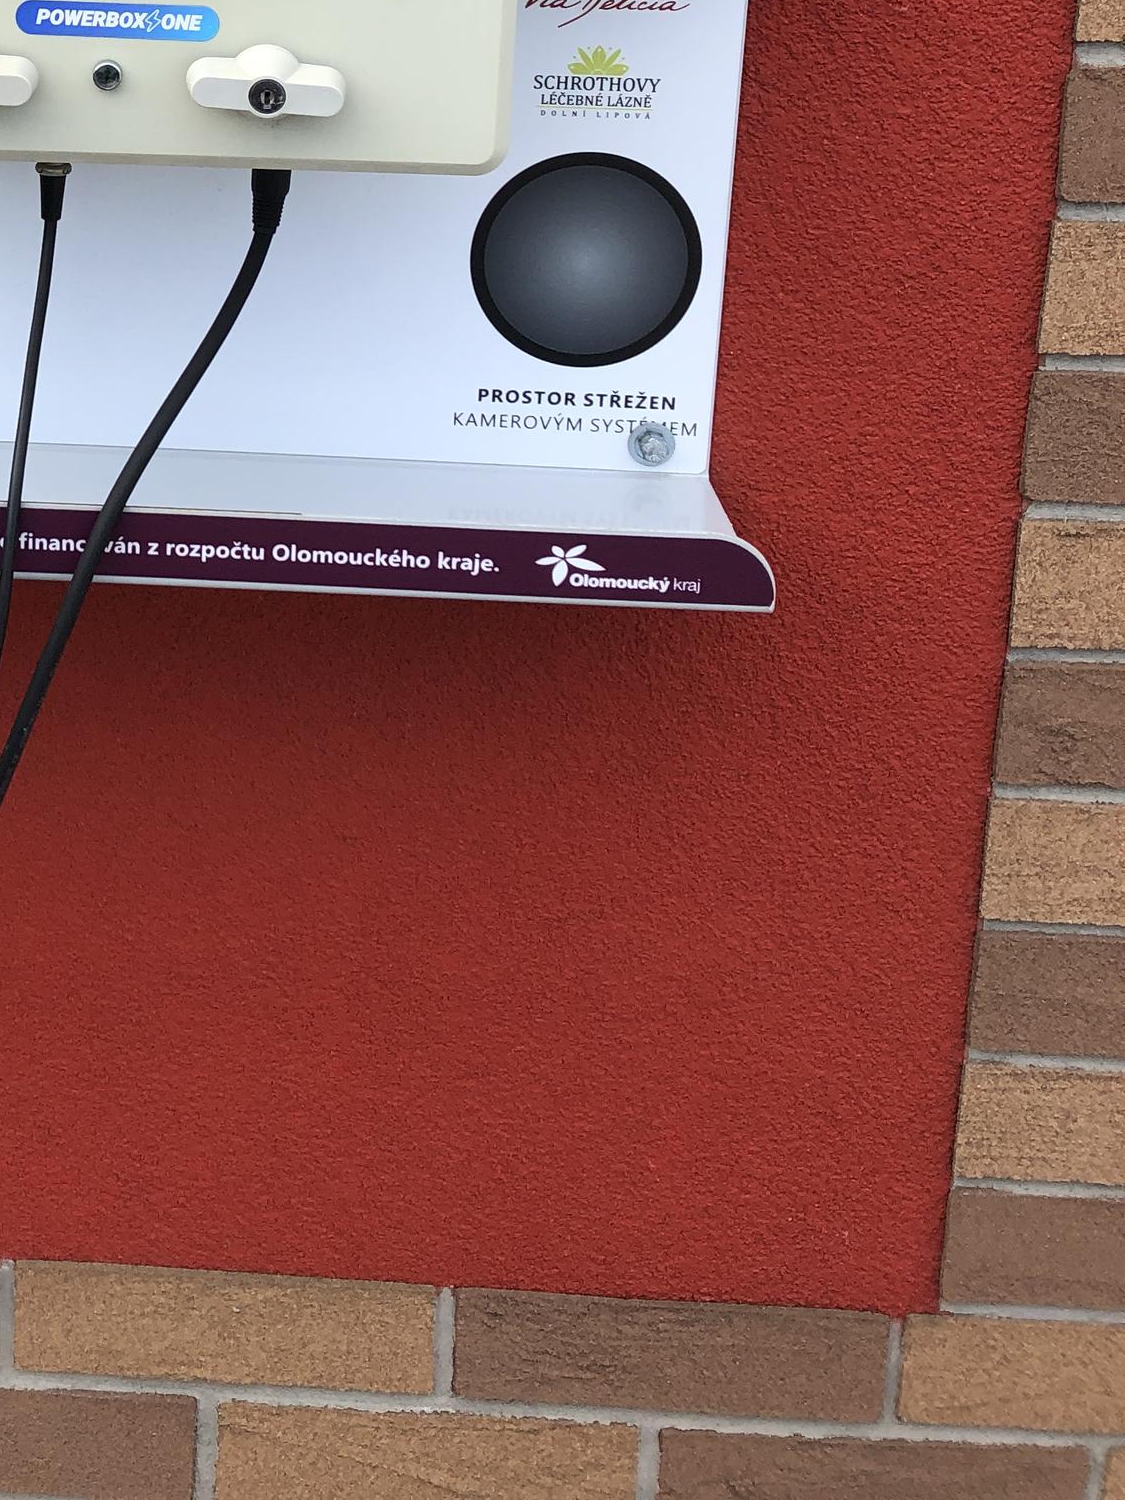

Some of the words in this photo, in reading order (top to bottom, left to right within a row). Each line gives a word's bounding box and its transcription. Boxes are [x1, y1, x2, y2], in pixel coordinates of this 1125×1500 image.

[533, 75, 661, 93] SCHROTHOVY
[541, 92, 603, 106] LÉČEBNÉ
[607, 94, 652, 108] LÁZNĚ
[597, 111, 651, 120] LIPOVÁ
[478, 388, 576, 407] PROSTOR
[583, 390, 675, 410] STŘEŽEN
[453, 412, 582, 432] KAMEROVÝM
[590, 417, 697, 437] SYSTEM
[19, 532, 140, 555] financván
[148, 542, 159, 555] z
[166, 542, 265, 562] rozpočtu
[272, 545, 431, 569] Olomouckého
[438, 552, 499, 576] kraje.
[569, 573, 670, 594] Olomoucký
[673, 576, 701, 595] kraj
